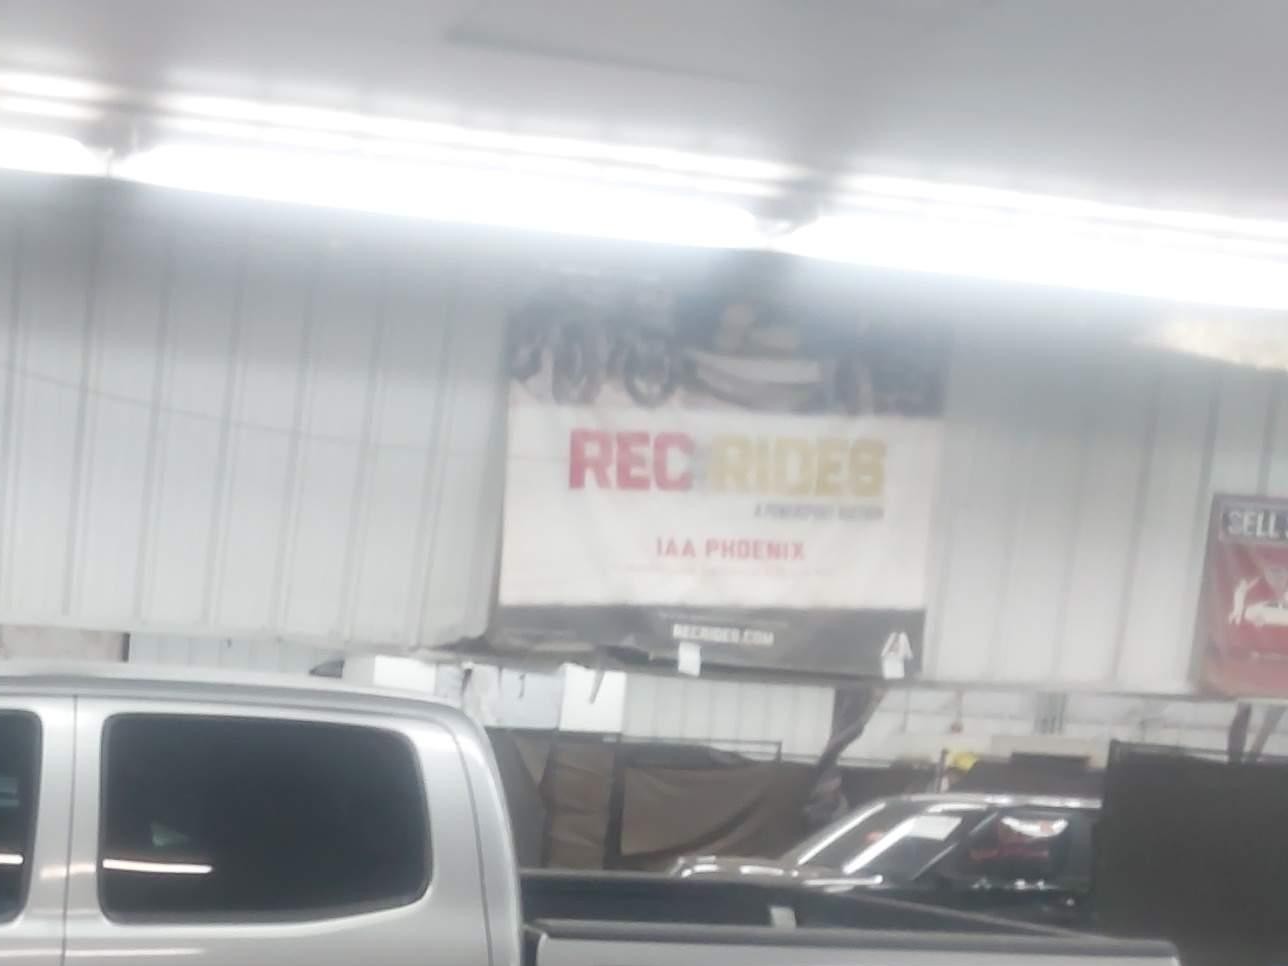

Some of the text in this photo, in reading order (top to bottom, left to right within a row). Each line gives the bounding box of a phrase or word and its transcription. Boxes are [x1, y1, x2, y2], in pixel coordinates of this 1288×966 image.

[568, 428, 887, 497] REC RIDES
[1227, 510, 1280, 538] SELL
[657, 536, 805, 561] IAA PHOENIX
